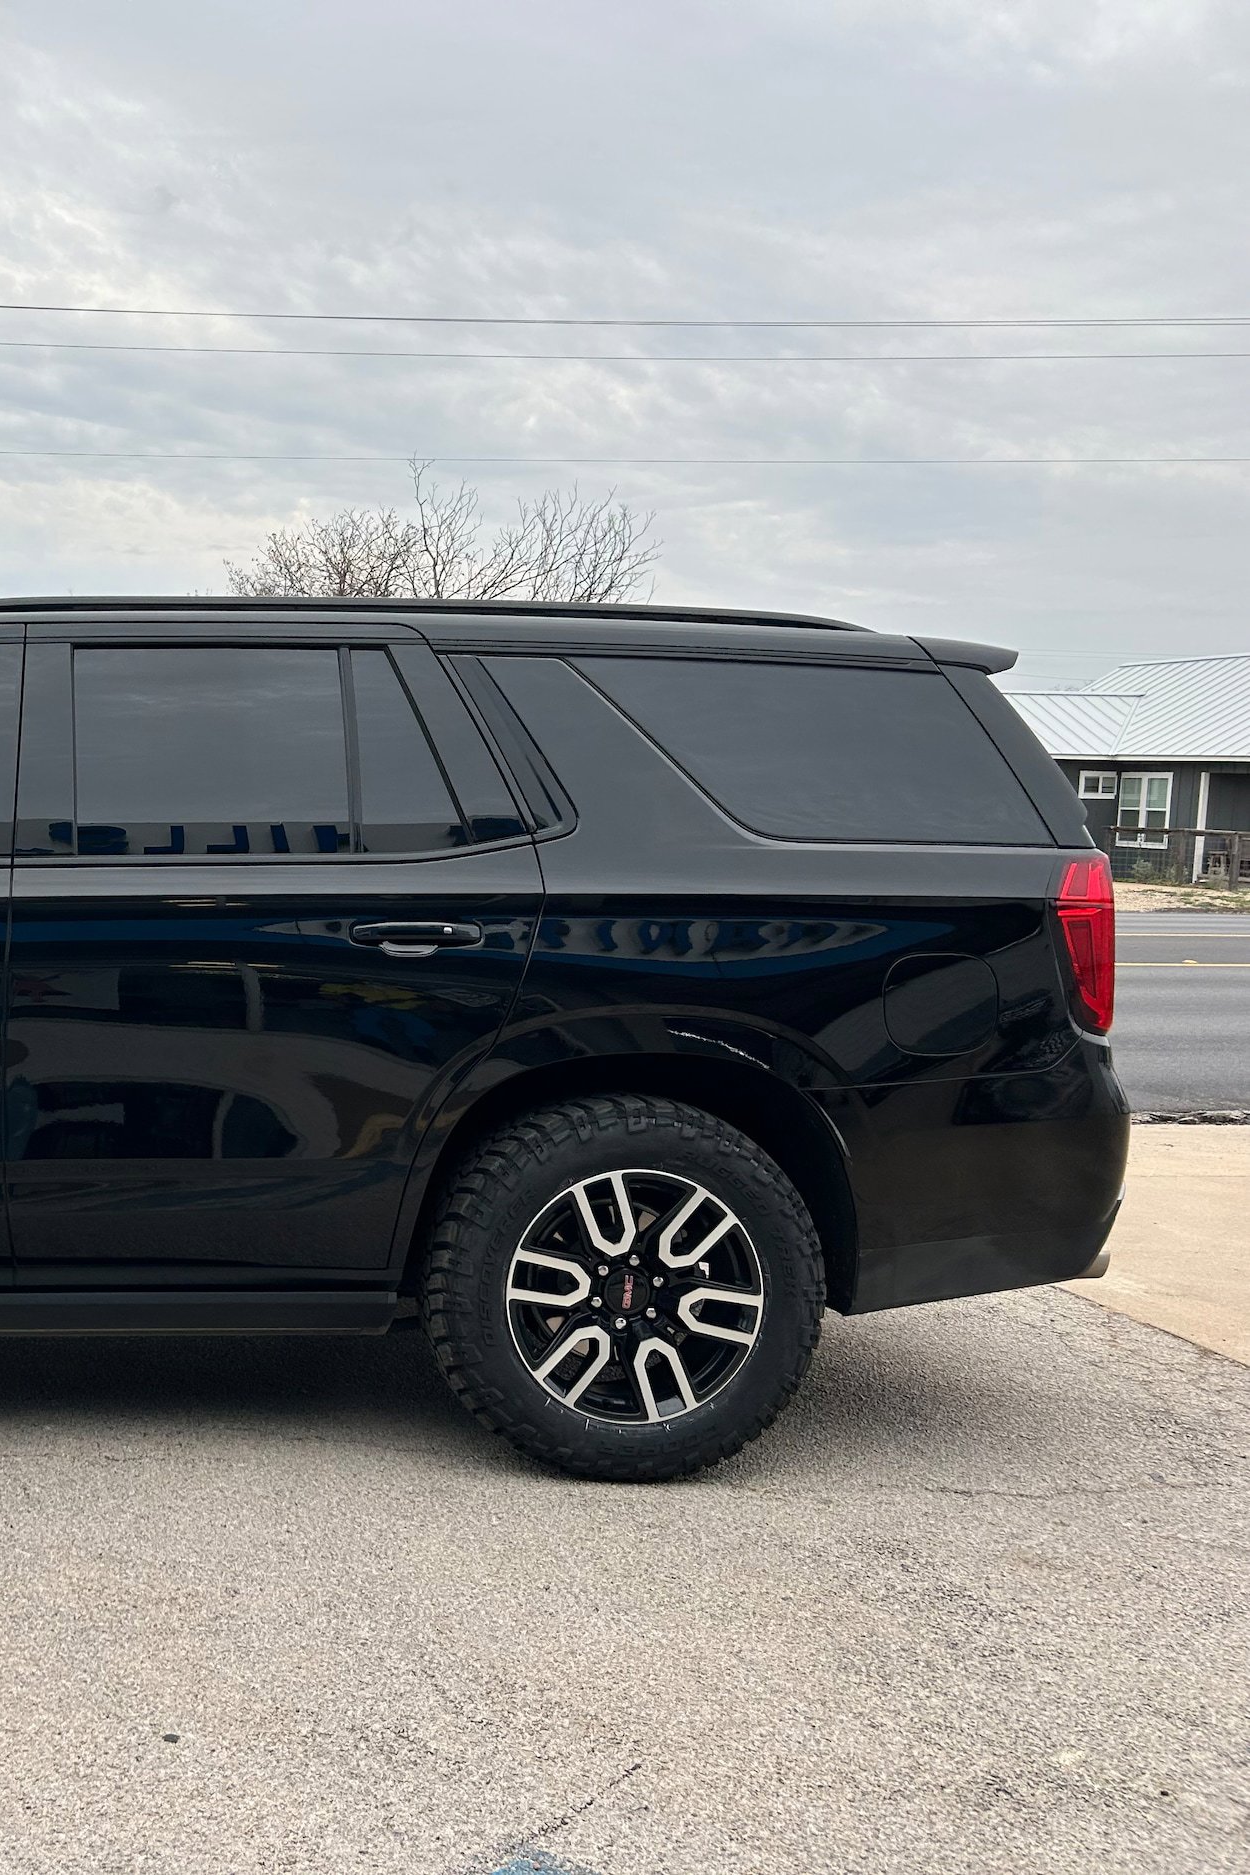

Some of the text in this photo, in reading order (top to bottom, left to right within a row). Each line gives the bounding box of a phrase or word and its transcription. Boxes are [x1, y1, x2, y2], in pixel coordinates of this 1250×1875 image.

[478, 1188, 537, 1346] DISCOVERER
[621, 1274, 634, 1309] GMC
[671, 1151, 798, 1298] RUGGED TREK
